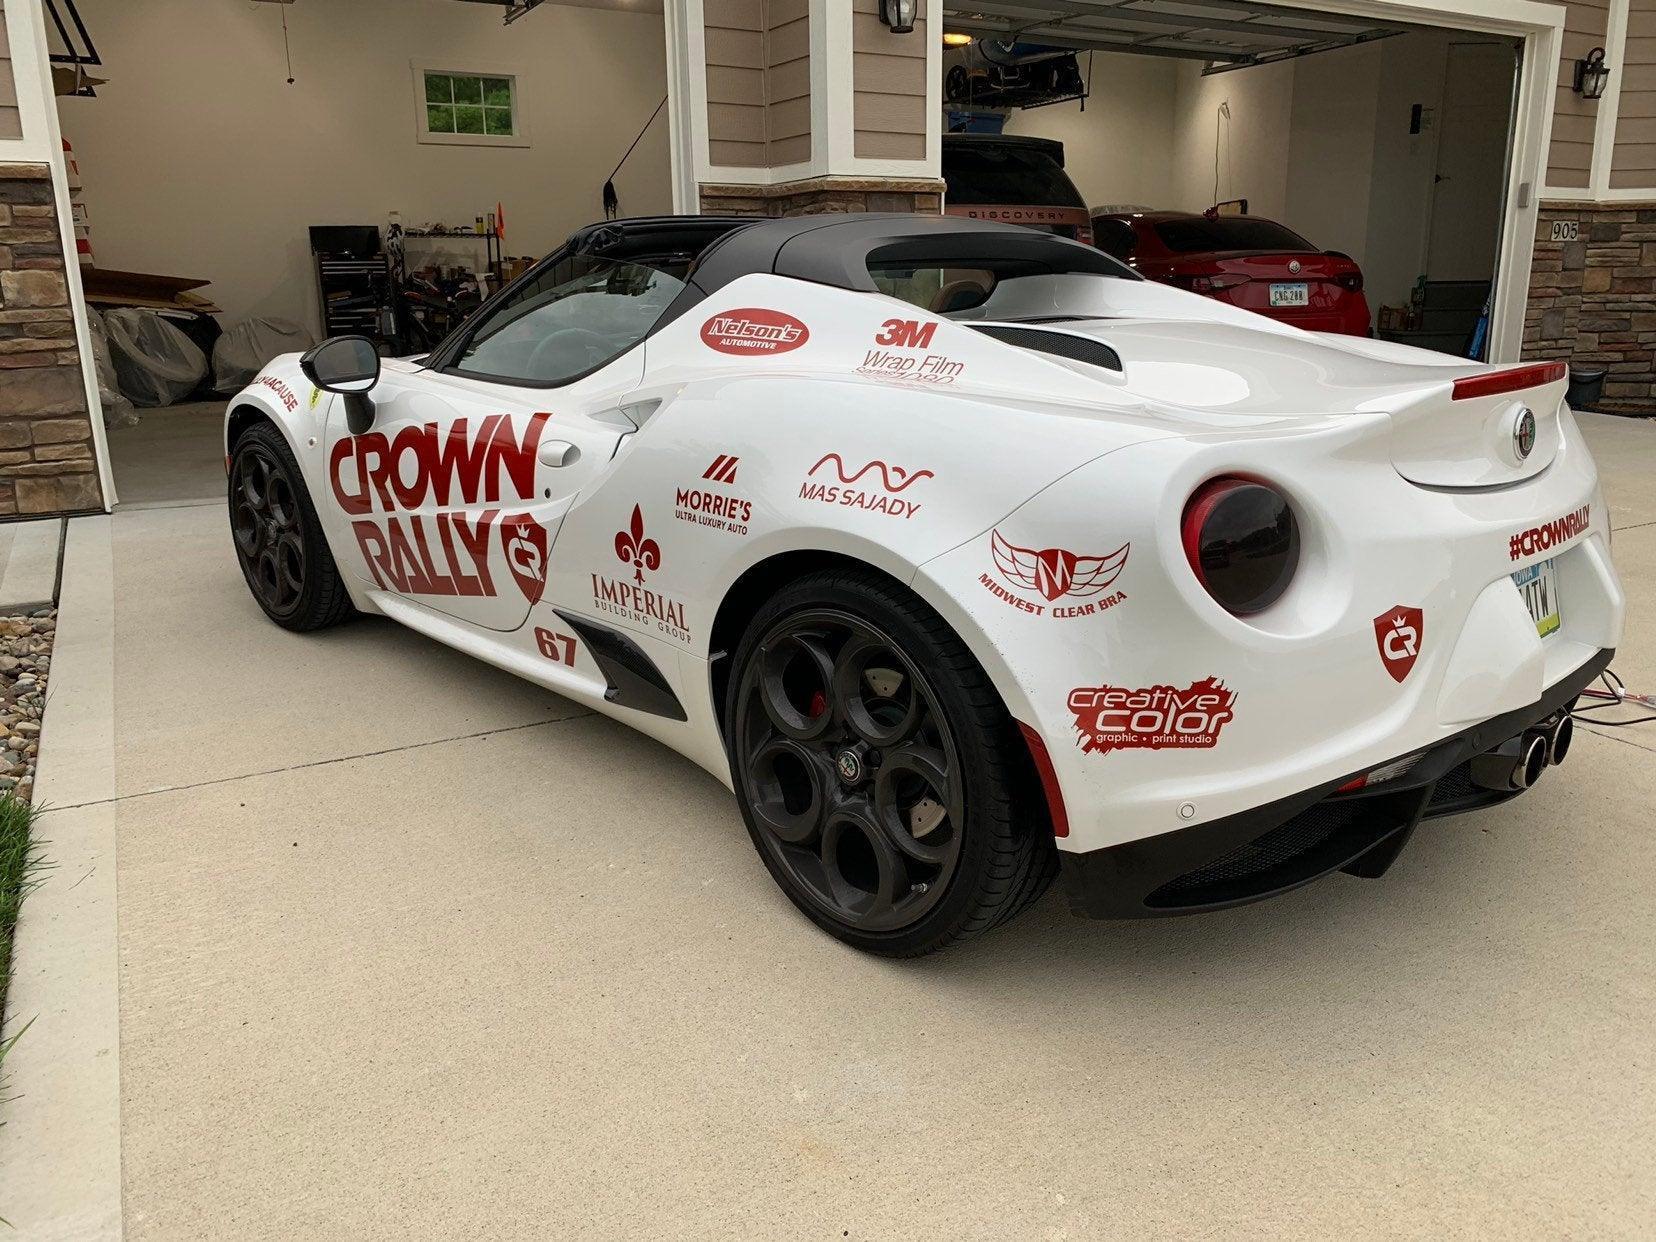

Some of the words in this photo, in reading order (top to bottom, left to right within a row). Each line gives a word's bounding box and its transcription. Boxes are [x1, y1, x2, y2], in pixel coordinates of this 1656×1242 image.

[968, 211, 1065, 220] DISCOVERY
[1553, 222, 1578, 239] 905
[708, 317, 803, 342] Nelson's
[719, 338, 777, 350] AUTOMOTIVE
[875, 318, 938, 349] 3M
[863, 350, 916, 373] Wrap
[920, 355, 965, 376] Film
[330, 413, 553, 515] CROWN
[676, 487, 752, 522] MORRIE'S
[799, 482, 839, 503] MAS
[839, 489, 922, 520] SAJADY
[675, 510, 697, 524] ULTRA
[698, 515, 726, 531] LUXURY
[727, 520, 748, 535] AUTO
[1510, 504, 1590, 561] #CROWNRALLY
[351, 509, 501, 597] RALLY
[591, 573, 690, 632] IMPERIAL
[978, 573, 1045, 616] MIDWEST
[1052, 604, 1096, 618] CLEAR
[1099, 590, 1128, 611] BRA
[1519, 576, 1549, 623] ATW
[595, 600, 649, 626] BUILDING
[657, 621, 692, 645] GROUP
[534, 626, 577, 667] 67
[1383, 625, 1417, 661] CR
[1069, 689, 1220, 710] creative
[1095, 702, 1228, 735] color
[1096, 733, 1138, 744] graphic
[1152, 734, 1177, 744] print
[1179, 733, 1212, 744] studio
